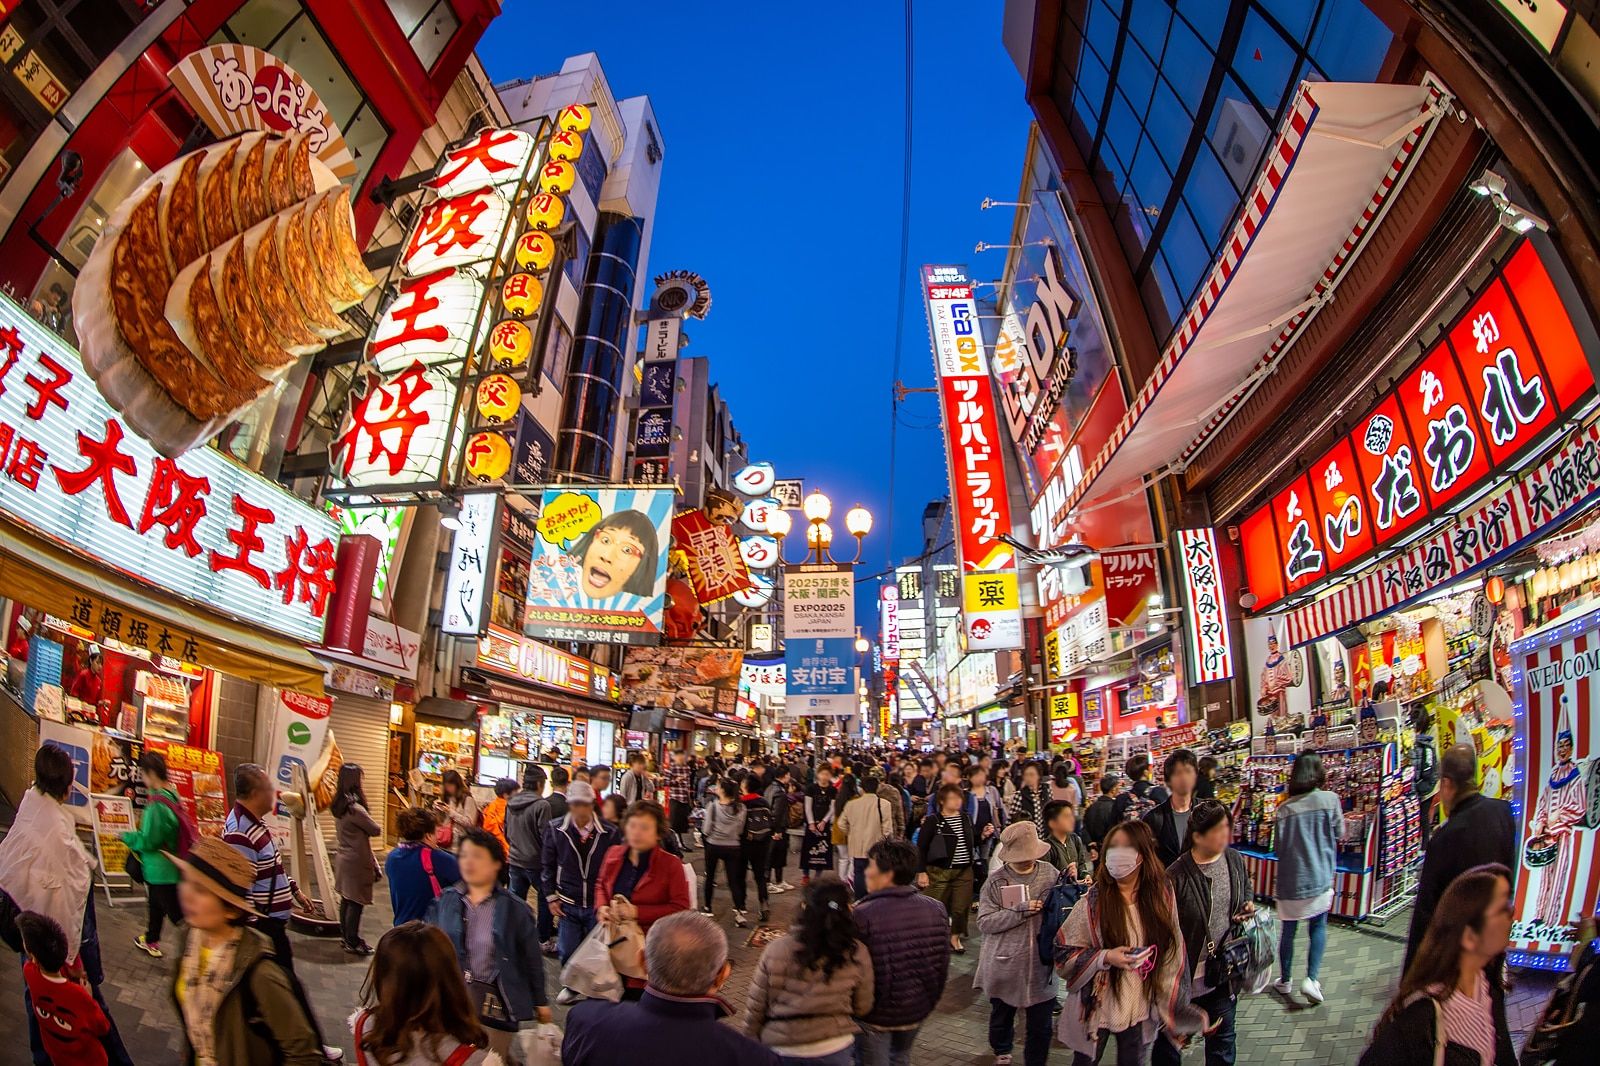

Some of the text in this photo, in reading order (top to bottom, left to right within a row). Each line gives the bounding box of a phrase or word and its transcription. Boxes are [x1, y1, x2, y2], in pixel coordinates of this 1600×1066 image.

[213, 57, 328, 153] あっぱれ
[331, 127, 519, 478] 大阪王将
[937, 304, 955, 373] TAX FREE SHOP
[637, 436, 670, 445] OCEAN
[644, 426, 664, 434] BAR
[952, 380, 999, 544] ツルハドラッグ
[1529, 440, 1600, 523] 大阪紀
[51, 418, 338, 618] 大阪王将
[545, 501, 590, 529] おみやげ
[1103, 552, 1154, 572] ツルハ
[1384, 503, 1510, 594] 大阪みやげ
[788, 577, 850, 588] 2025万博を
[788, 588, 850, 599] 大阪・関西へ
[979, 580, 1004, 606] 薬
[1106, 574, 1145, 588] ドラッグ
[793, 603, 846, 612] EXPO2025
[1188, 538, 1226, 673] 大阪みやげ
[70, 596, 200, 663] 道頓堀本店
[791, 666, 847, 686] 支付宝
